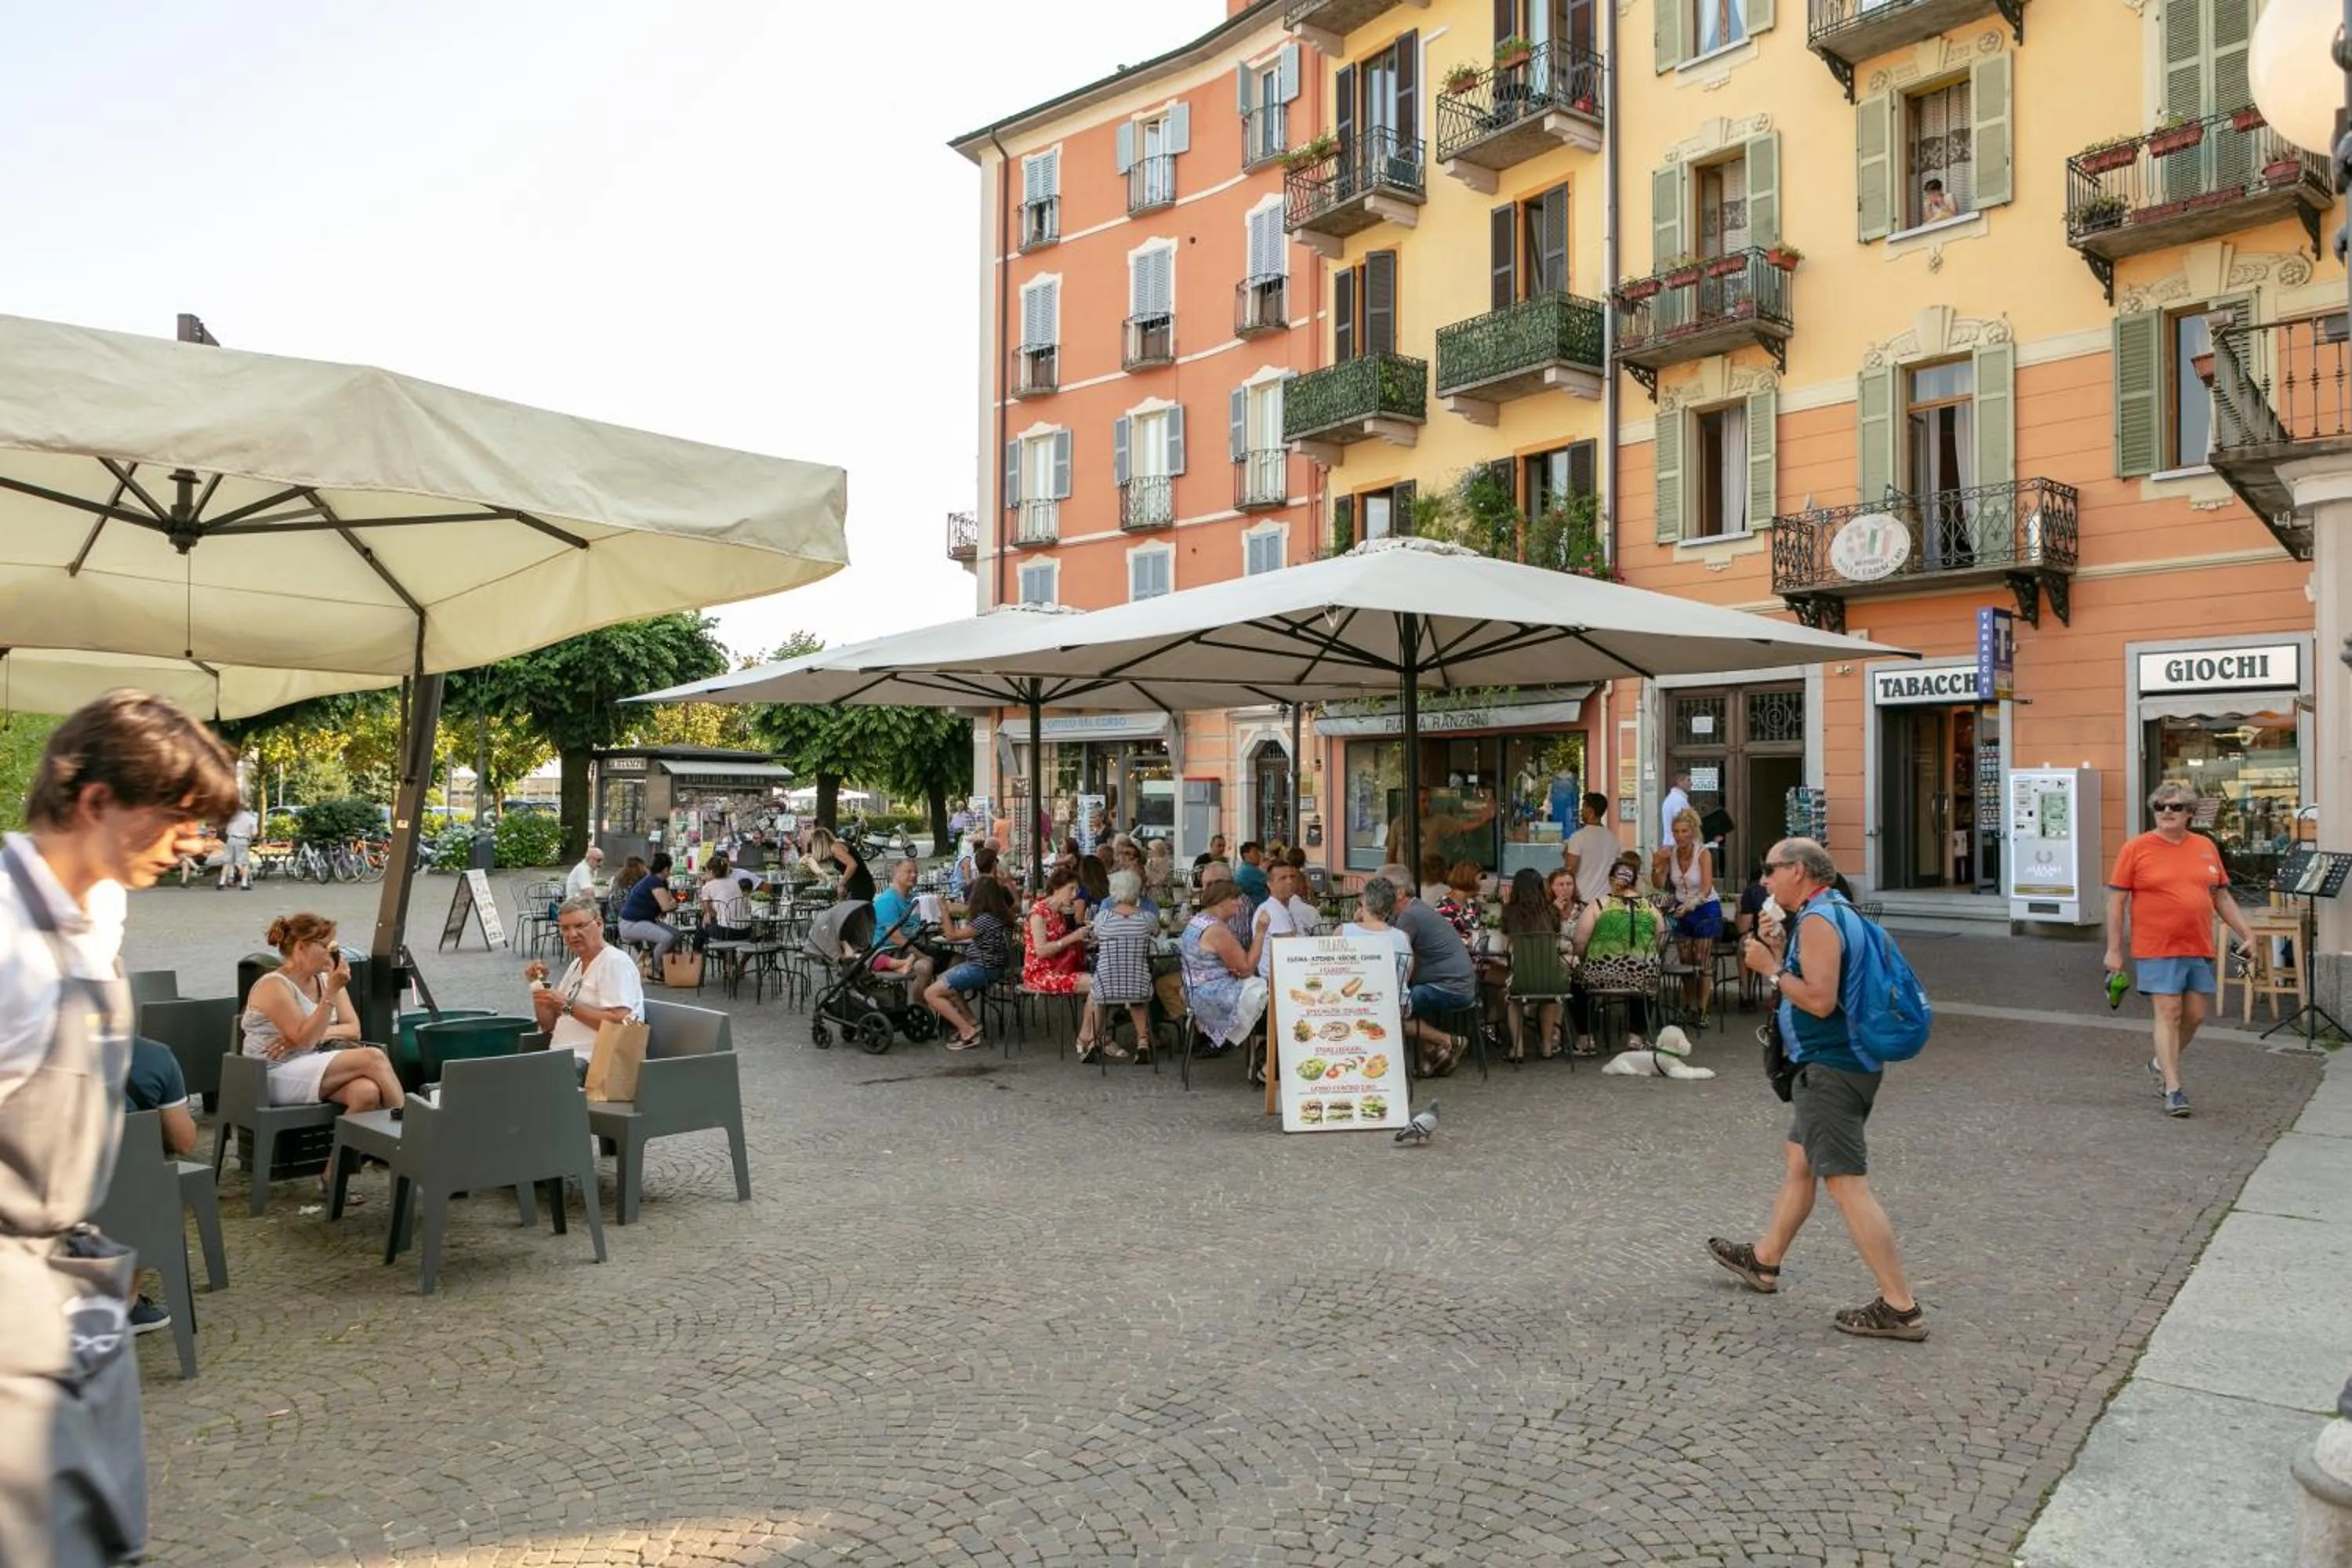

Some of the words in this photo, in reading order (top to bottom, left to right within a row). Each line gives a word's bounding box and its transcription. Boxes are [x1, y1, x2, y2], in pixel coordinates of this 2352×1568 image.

[1994, 616, 2010, 661] T
[2165, 655, 2270, 682] GIOCHI
[1879, 673, 1978, 698] TABACCH
[1385, 717, 1426, 731] PIAA
[1432, 713, 1488, 728] RANZONI
